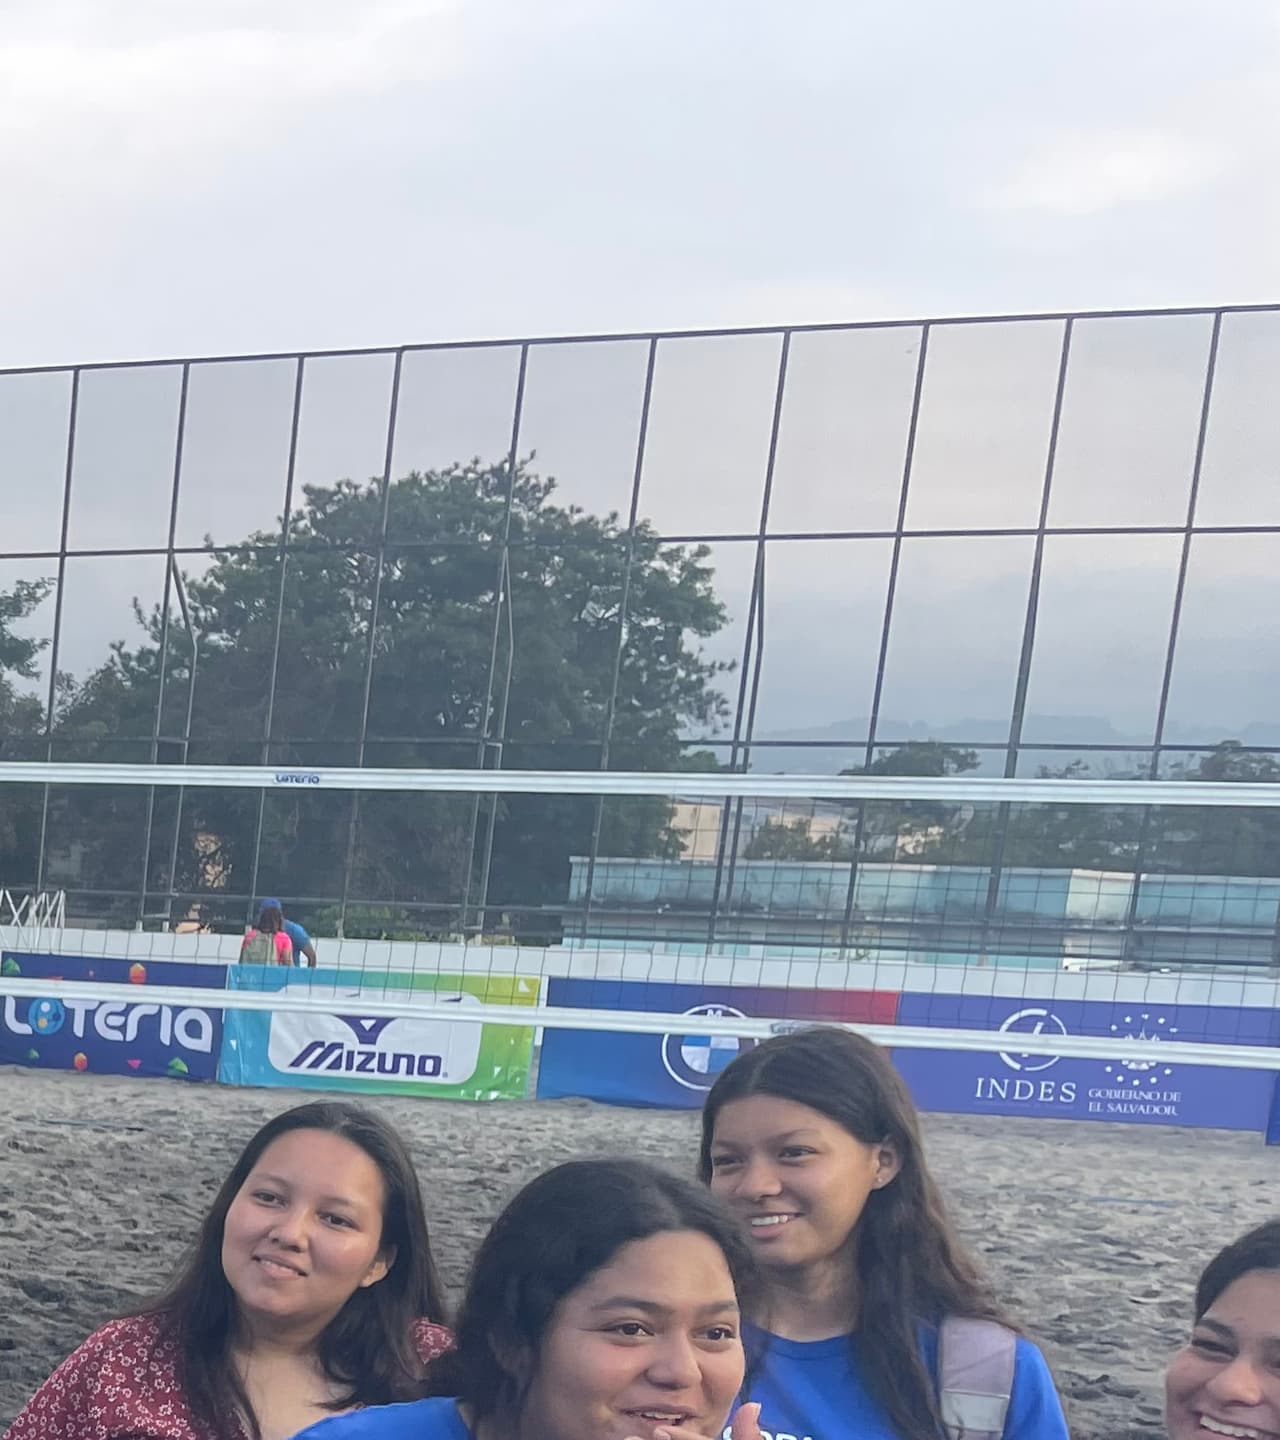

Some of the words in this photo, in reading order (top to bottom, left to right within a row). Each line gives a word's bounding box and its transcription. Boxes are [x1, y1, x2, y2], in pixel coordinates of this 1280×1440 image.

[975, 1078, 1077, 1103] INDES
[1088, 1088, 1161, 1102] GOBIERNO
[1163, 1091, 1181, 1102] DE
[1088, 1102, 1104, 1113] EL
[1106, 1102, 1179, 1116] SALVADOR
